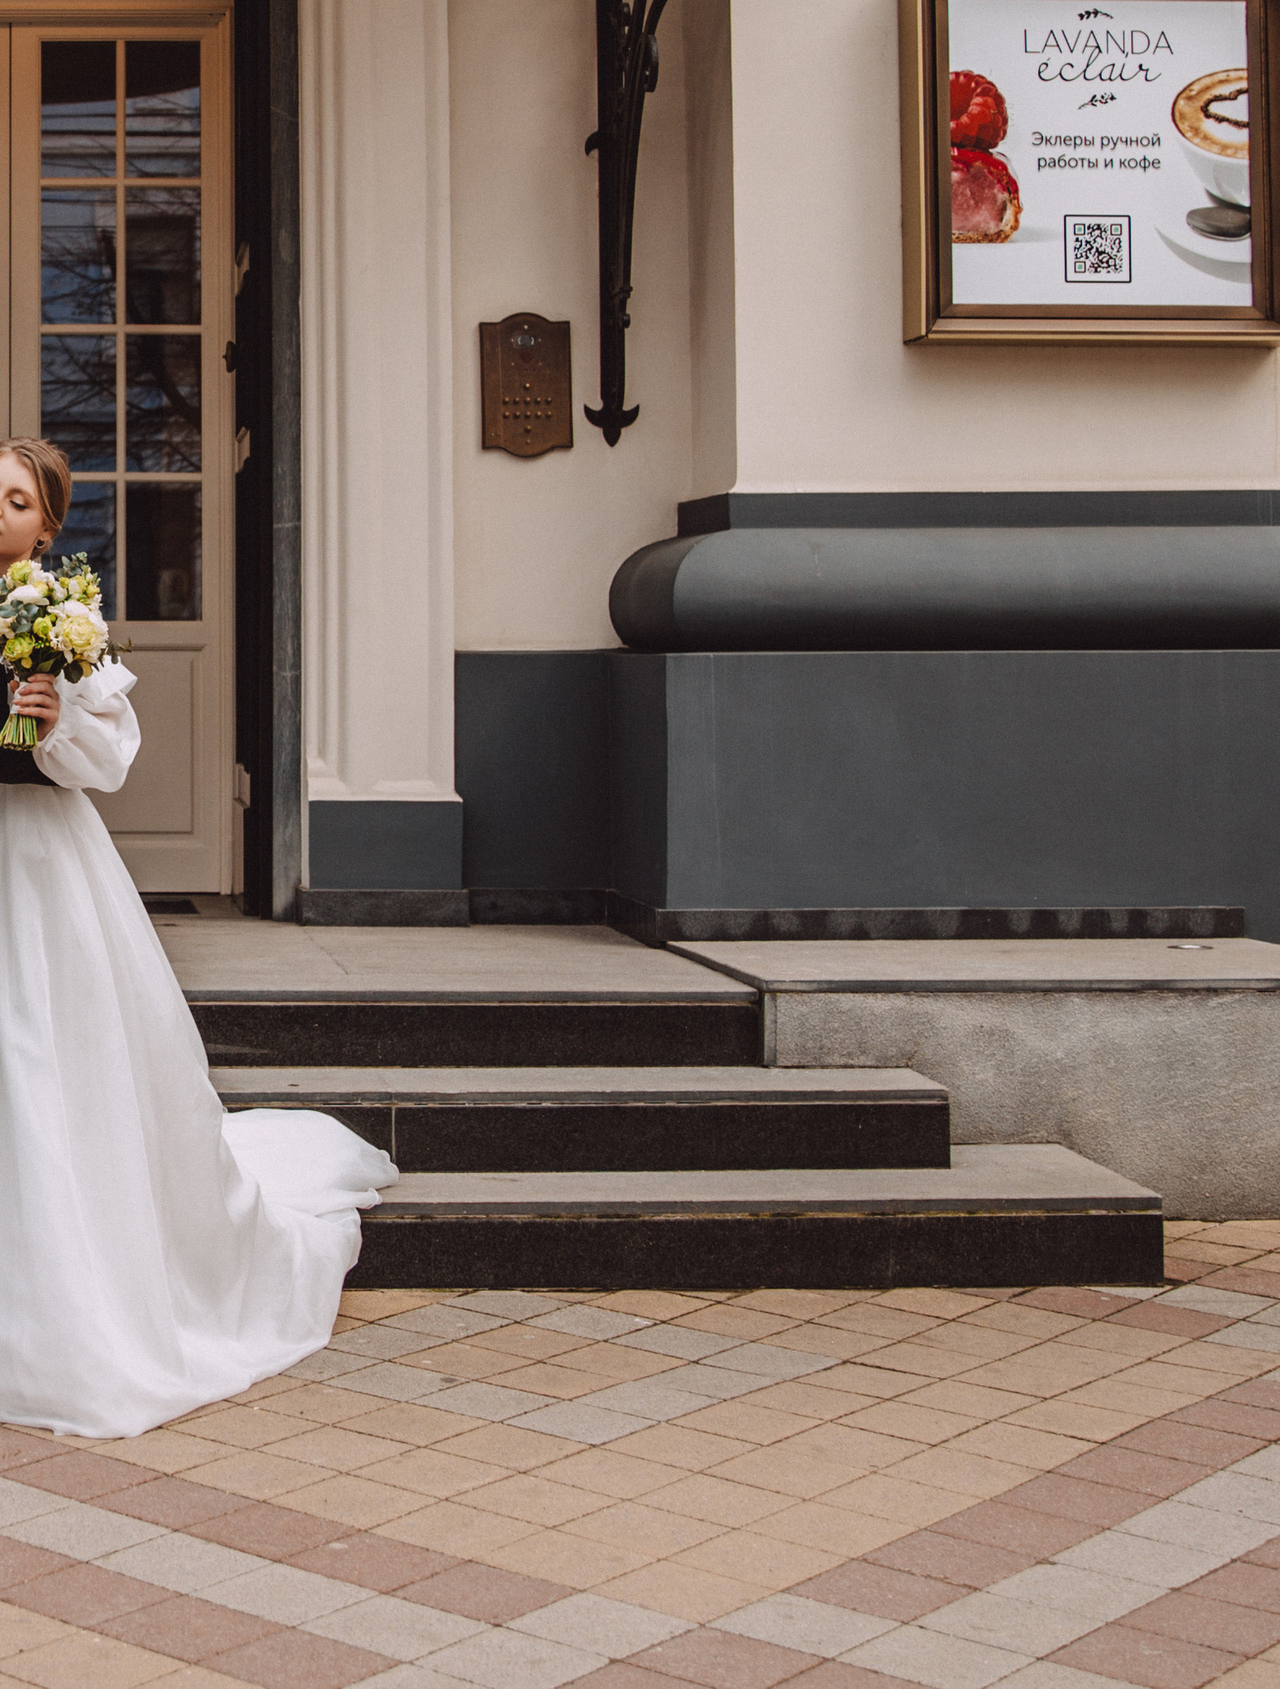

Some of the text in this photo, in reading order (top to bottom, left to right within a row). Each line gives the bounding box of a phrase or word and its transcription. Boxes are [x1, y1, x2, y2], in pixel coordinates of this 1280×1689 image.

[1023, 28, 1174, 56] LAVANDA
[1037, 46, 1162, 83] éclair
[1031, 132, 1161, 151] Эклеры ручной
[1037, 153, 1161, 172] работы и кофе
